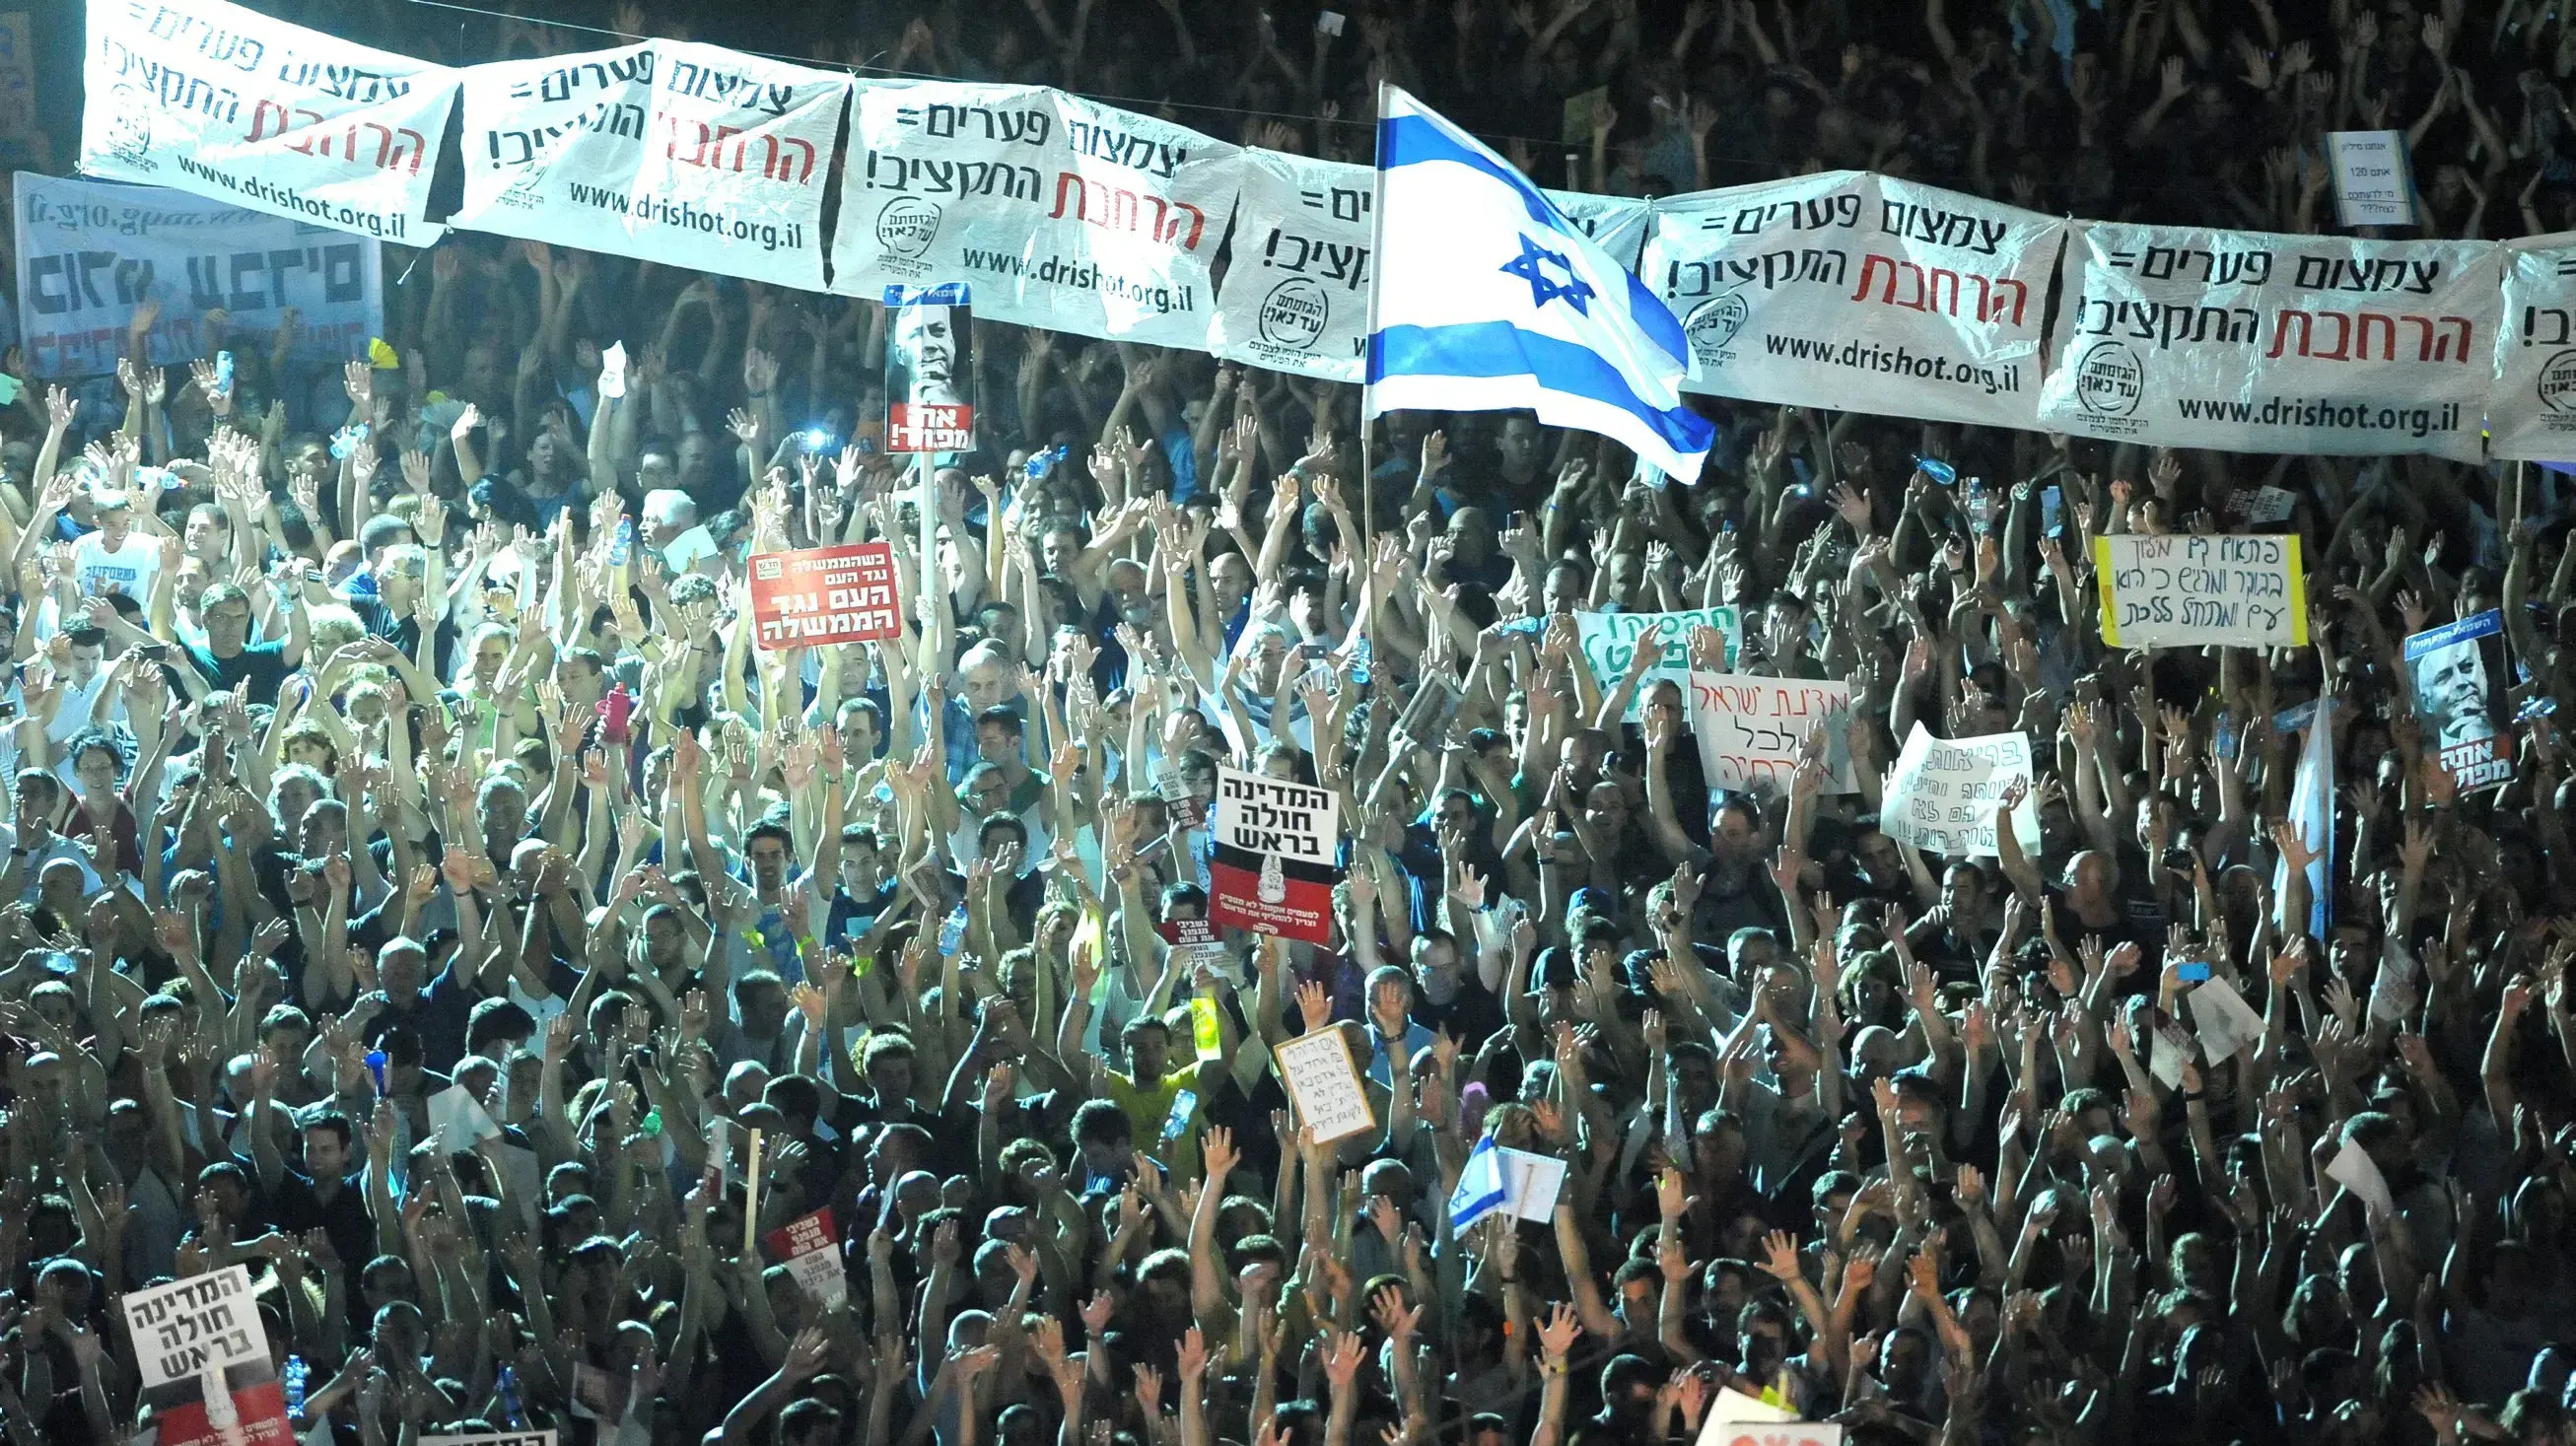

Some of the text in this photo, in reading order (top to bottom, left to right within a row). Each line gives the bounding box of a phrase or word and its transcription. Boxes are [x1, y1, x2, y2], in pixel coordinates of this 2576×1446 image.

[1070, 119, 1187, 177] צמצום
[2350, 168, 2367, 177] 120
[177, 154, 406, 239] www.drishot.org.il
[867, 150, 1205, 250] הרחבת התקציב!
[571, 182, 802, 251] www.drishot.org.il
[1882, 197, 2007, 256] צמצום
[918, 229, 933, 241] עד
[963, 247, 1193, 313] www.drishot.org.il
[1667, 248, 2028, 328] הרחבת התקציב!
[2295, 254, 2439, 295] צמצום
[1265, 307, 1321, 333] עד כאן!
[1277, 295, 1322, 316] הגזמתם
[2075, 296, 2261, 350] התקציב!
[2266, 310, 2472, 364] הרחבת
[1249, 341, 1281, 353] לצמצם
[1767, 333, 2019, 394] www.drishot.org.il
[2090, 362, 2136, 380] הגזמתם
[2081, 375, 2137, 397] עד כאן!
[2178, 396, 2459, 438] www.drishot.org.il
[792, 554, 885, 574] כשהממשלה
[2188, 535, 2209, 567] קם
[2221, 536, 2279, 564] פתאום
[824, 570, 887, 585] נגד העם
[2117, 569, 2145, 591] הוא
[2179, 567, 2227, 594] ומרגיש
[2235, 570, 2283, 603] בבוקר
[771, 585, 891, 615] העם נגד
[2122, 595, 2285, 631] עם ומתחיל ללכת
[762, 609, 894, 641] הממשלה
[1691, 675, 1847, 717] מדינת ישראל
[1734, 716, 1796, 752] לכל
[1720, 755, 1839, 785] ארחיה
[2441, 741, 2492, 772] אתה
[1223, 778, 1329, 811] המדינה
[1913, 797, 1976, 822] הם לא
[1241, 803, 1311, 832] חולה
[1234, 827, 1321, 856] בראש
[1287, 908, 1319, 919] לפעמים
[131, 1271, 242, 1329] המדינה
[158, 1304, 235, 1349] חולה
[160, 1329, 252, 1378] בראש
